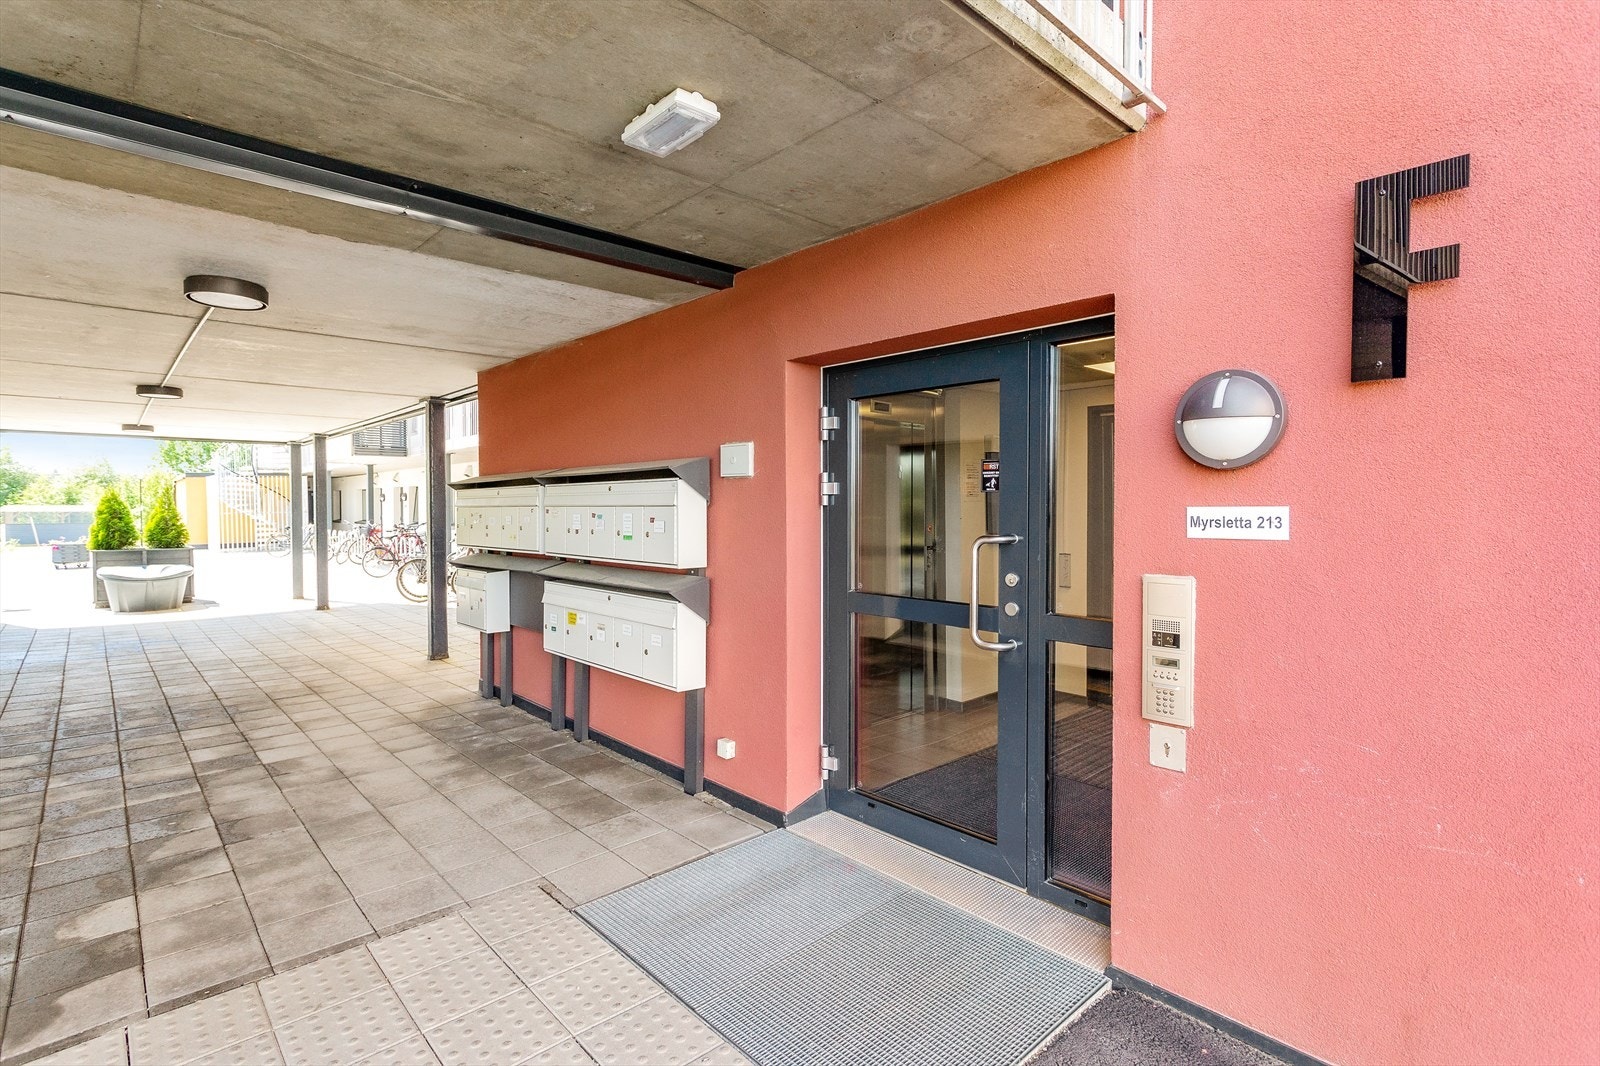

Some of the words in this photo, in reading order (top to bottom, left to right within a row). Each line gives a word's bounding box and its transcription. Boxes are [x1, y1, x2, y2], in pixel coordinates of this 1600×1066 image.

[1351, 153, 1470, 382] F
[1190, 515, 1252, 531] Myrsletta
[1256, 516, 1283, 529] 213
